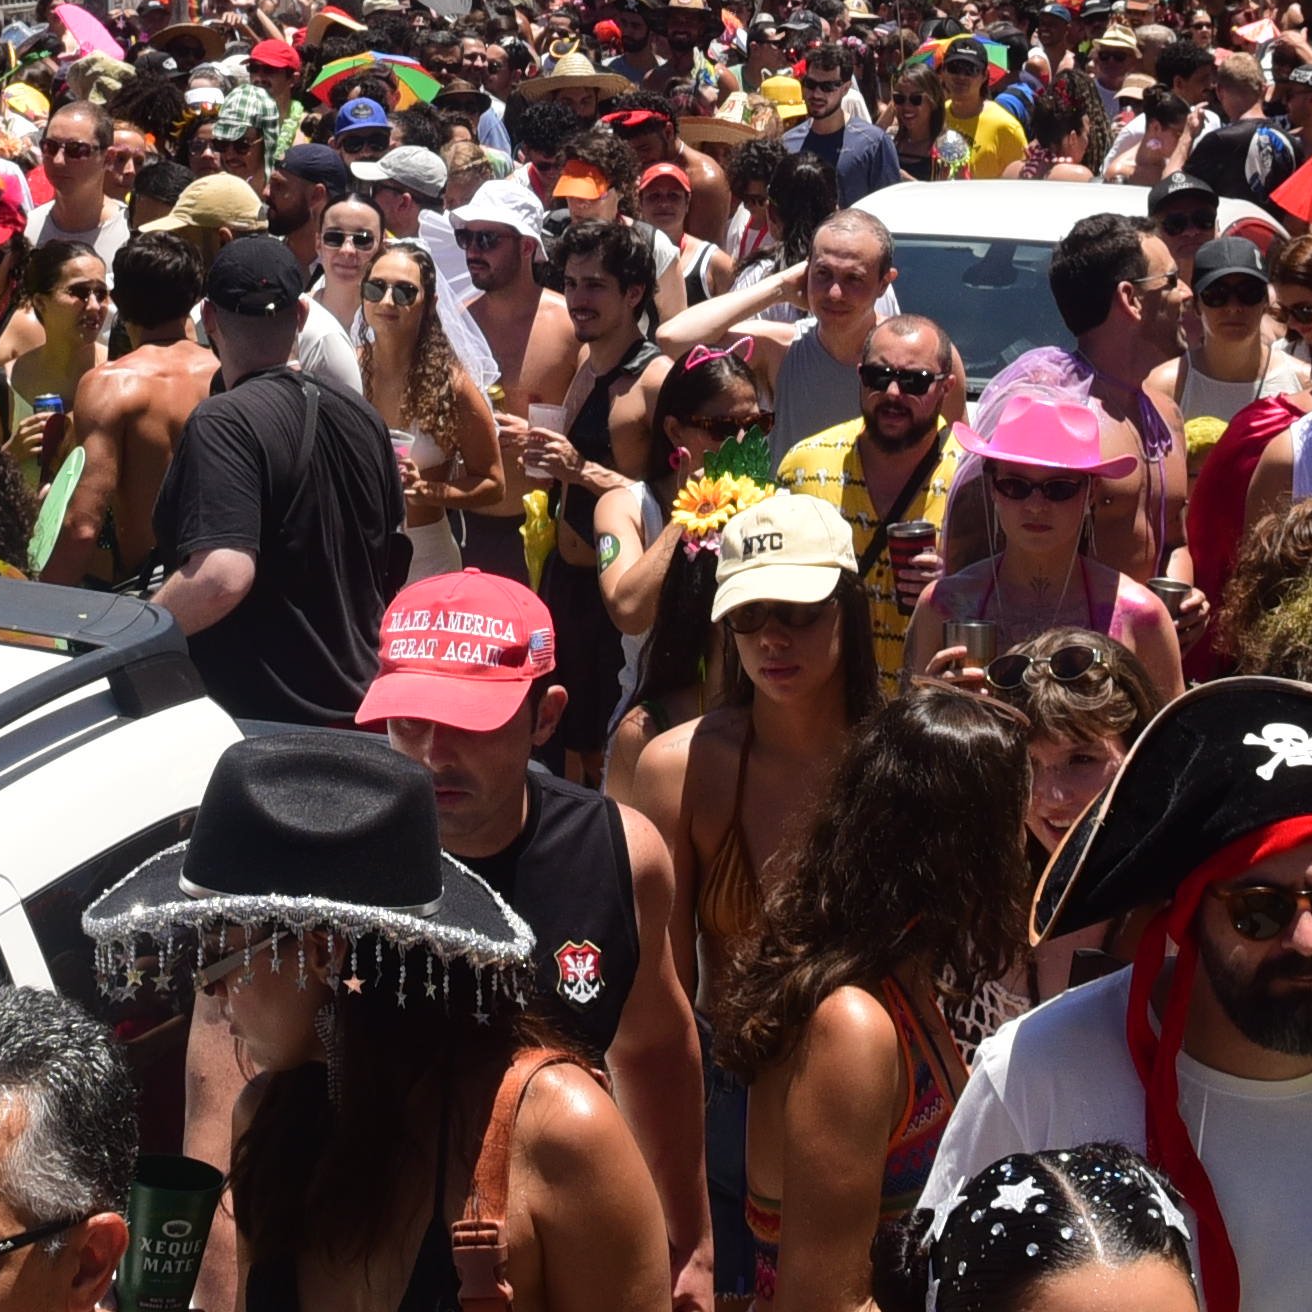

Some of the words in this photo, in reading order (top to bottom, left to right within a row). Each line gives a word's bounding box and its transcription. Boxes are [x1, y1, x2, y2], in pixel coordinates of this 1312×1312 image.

[742, 532, 784, 556] NYC
[386, 609, 431, 632] MAKE
[431, 610, 517, 643] AMERICA
[389, 638, 438, 660] GREAT
[441, 641, 504, 667] AGAIN
[139, 1236, 203, 1257] XEQUE
[143, 1256, 196, 1273] MATE
